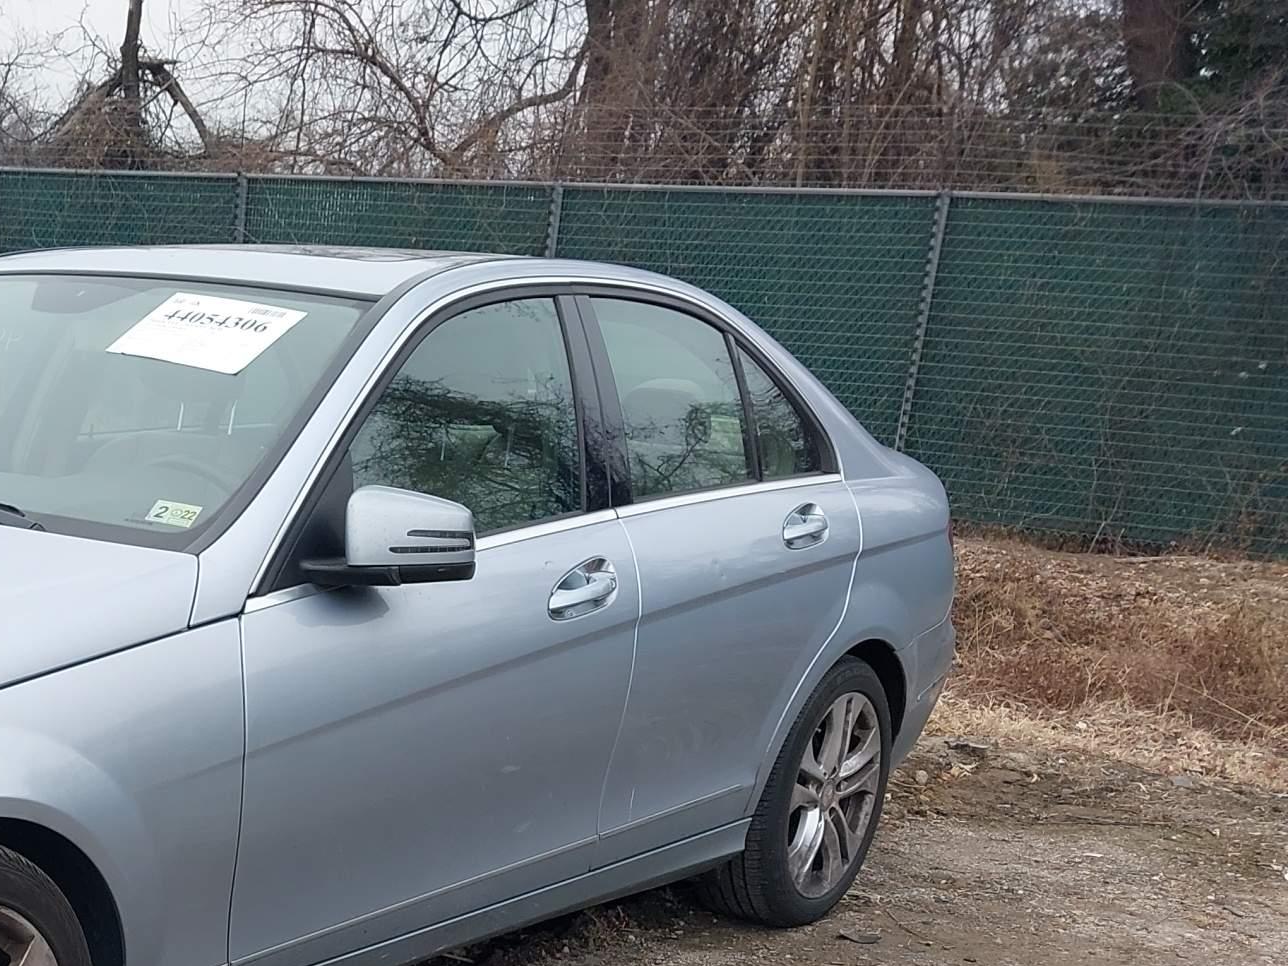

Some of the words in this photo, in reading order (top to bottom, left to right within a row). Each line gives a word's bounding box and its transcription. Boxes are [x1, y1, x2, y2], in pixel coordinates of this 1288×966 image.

[165, 308, 271, 333] 44054306
[153, 506, 169, 518] 2
[181, 510, 197, 520] 22
